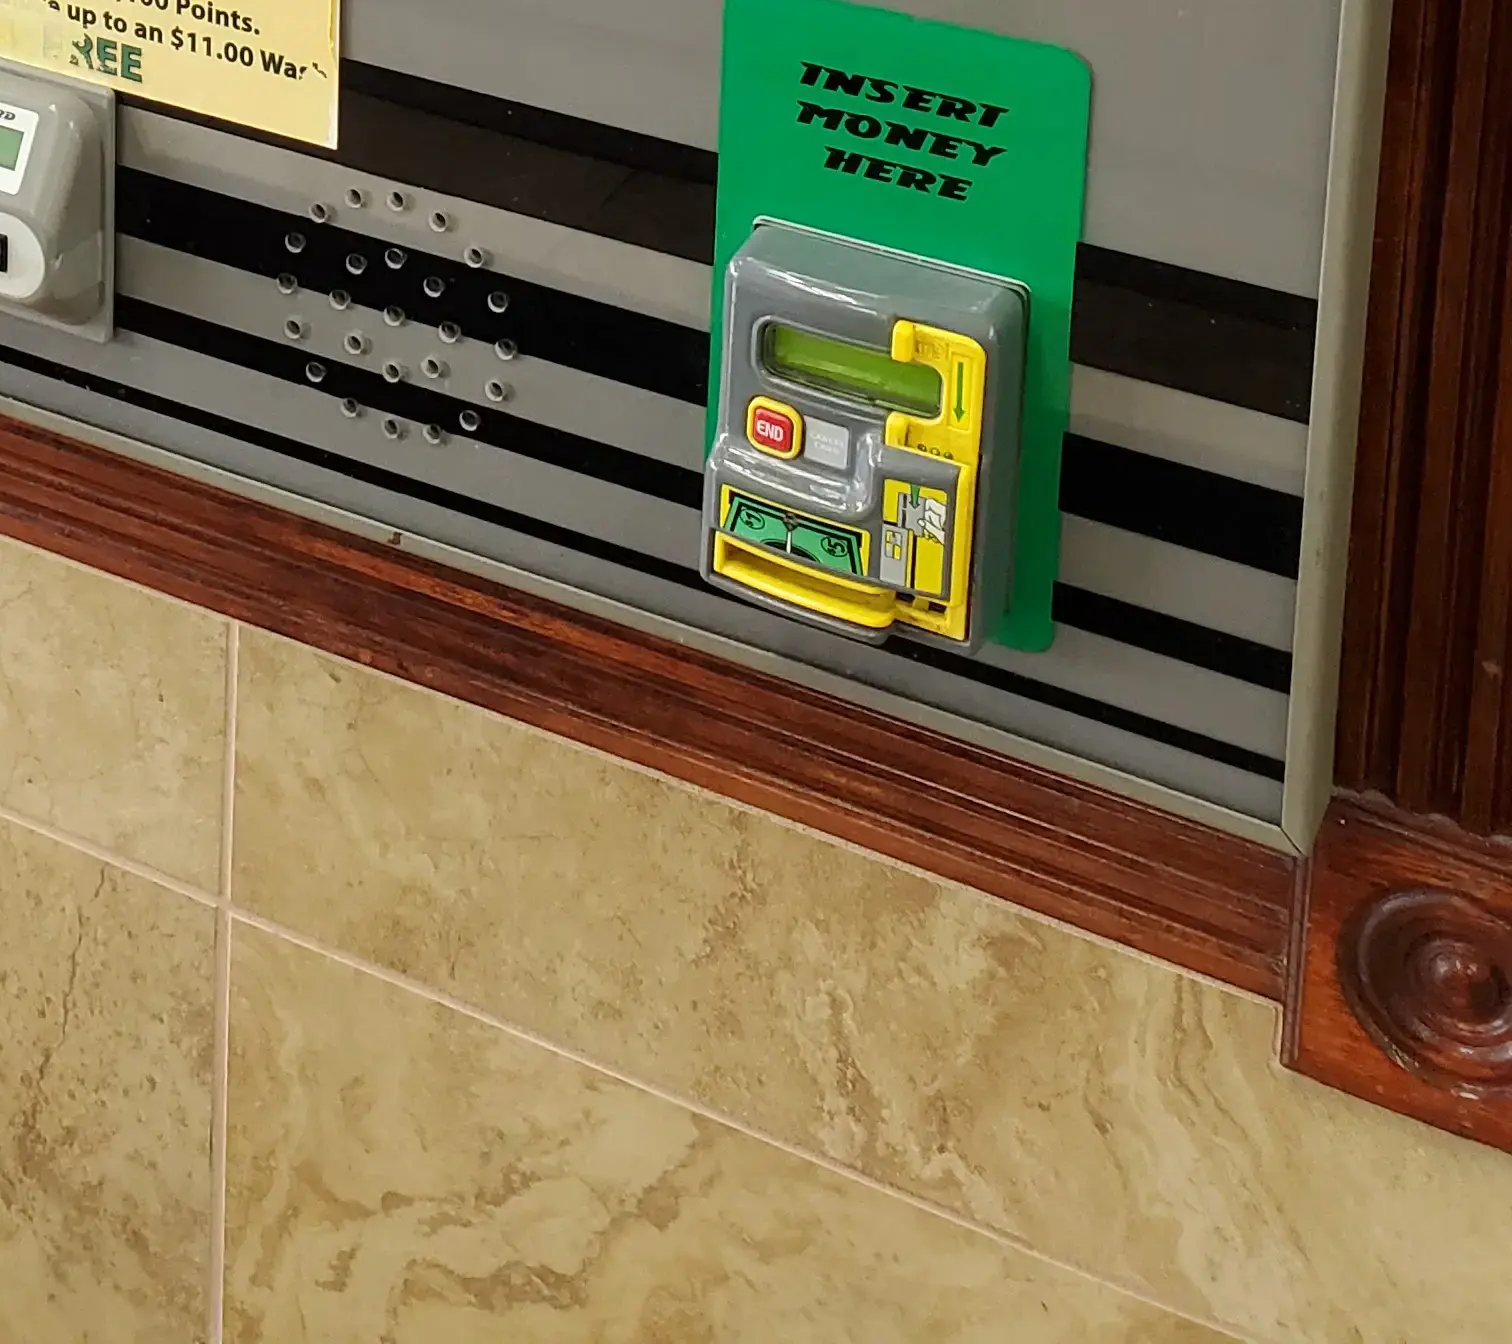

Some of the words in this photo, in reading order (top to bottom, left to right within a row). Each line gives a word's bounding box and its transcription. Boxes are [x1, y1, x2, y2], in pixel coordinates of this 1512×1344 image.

[67, 3, 98, 30] up
[103, 11, 128, 33] to
[134, 22, 164, 44] an
[170, 26, 254, 68] $11.00
[799, 61, 1010, 129] INSERT
[795, 100, 1008, 168] MONEY
[822, 146, 974, 202] HERE
[756, 419, 784, 443] END
